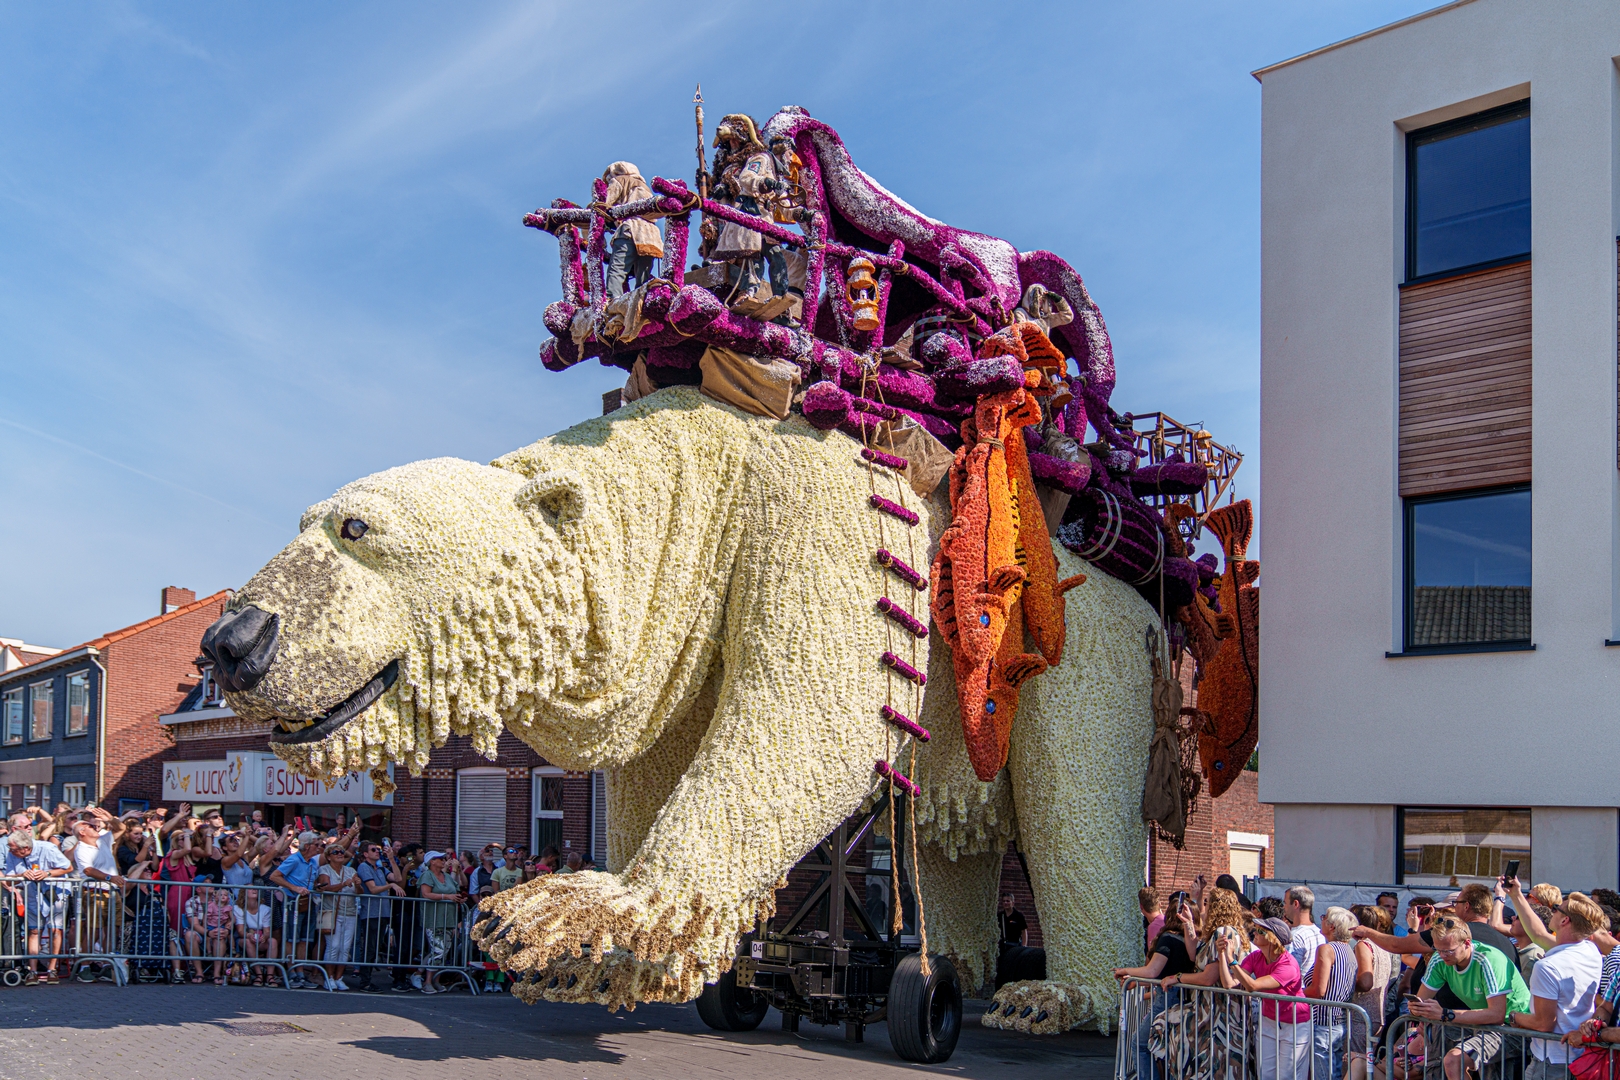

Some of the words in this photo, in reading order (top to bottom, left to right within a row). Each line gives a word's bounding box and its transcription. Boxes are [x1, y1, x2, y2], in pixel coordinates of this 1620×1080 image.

[195, 770, 227, 795] LUCK
[276, 768, 319, 796] SUSHI
[752, 943, 762, 953] 04
